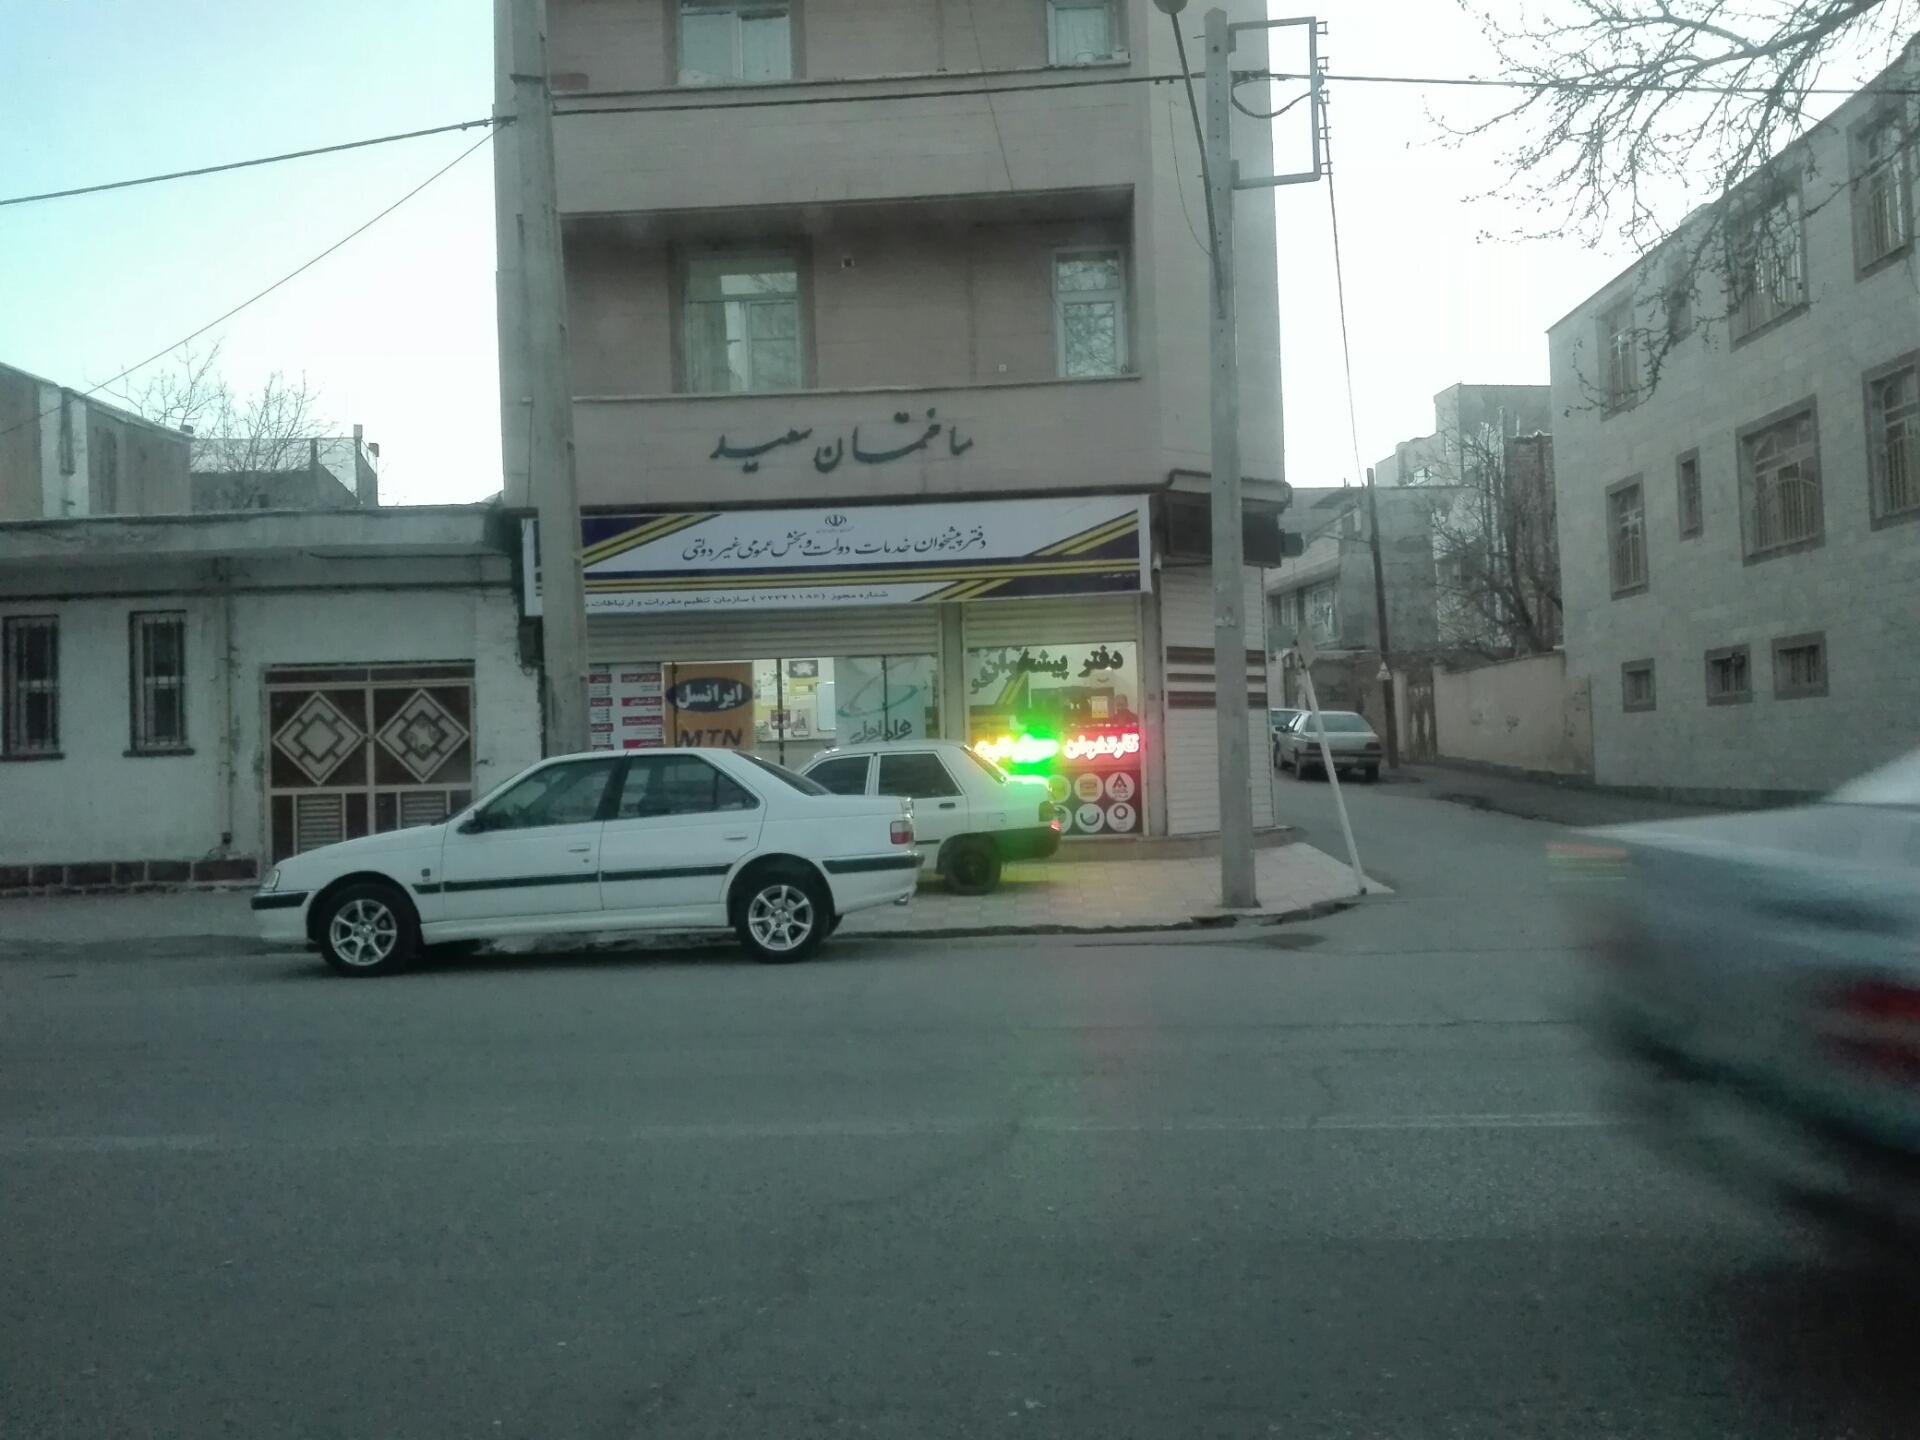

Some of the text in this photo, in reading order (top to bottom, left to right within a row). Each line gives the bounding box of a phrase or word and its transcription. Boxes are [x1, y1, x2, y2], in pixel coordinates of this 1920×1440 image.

[710, 428, 812, 474] سعید
[682, 525, 986, 561] دفتر پیشخوان خدمات دولت و بخش عمومی غیر دولتی
[591, 598, 634, 607] ارتباطات
[644, 597, 682, 606] مقررات
[684, 596, 711, 607] تنظیم
[713, 595, 748, 605] سازمان
[1078, 645, 1123, 677] دفتر
[675, 683, 743, 709] ایرانسل
[677, 728, 743, 748] MTN
